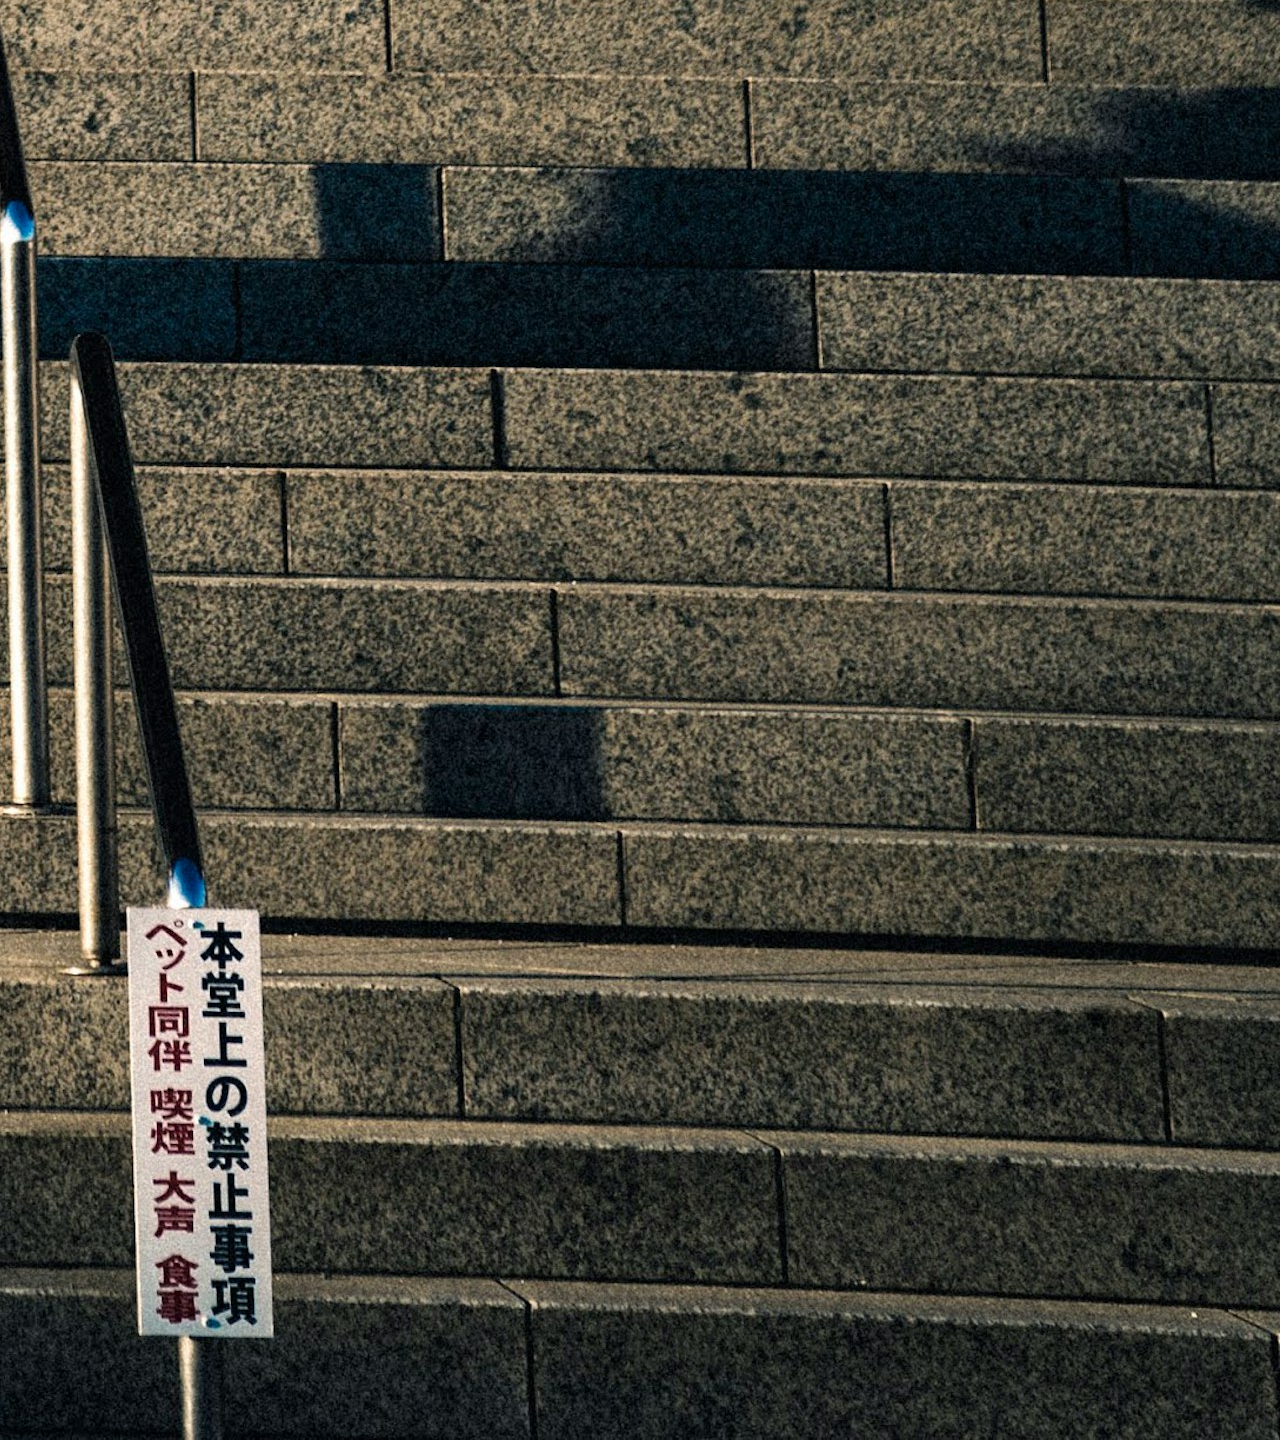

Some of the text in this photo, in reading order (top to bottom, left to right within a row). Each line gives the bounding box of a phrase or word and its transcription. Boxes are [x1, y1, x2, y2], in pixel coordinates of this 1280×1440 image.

[146, 919, 201, 1325] ペット同伴 喫煙 大声 食事
[200, 922, 257, 1326] 本堂上の禁止事項
